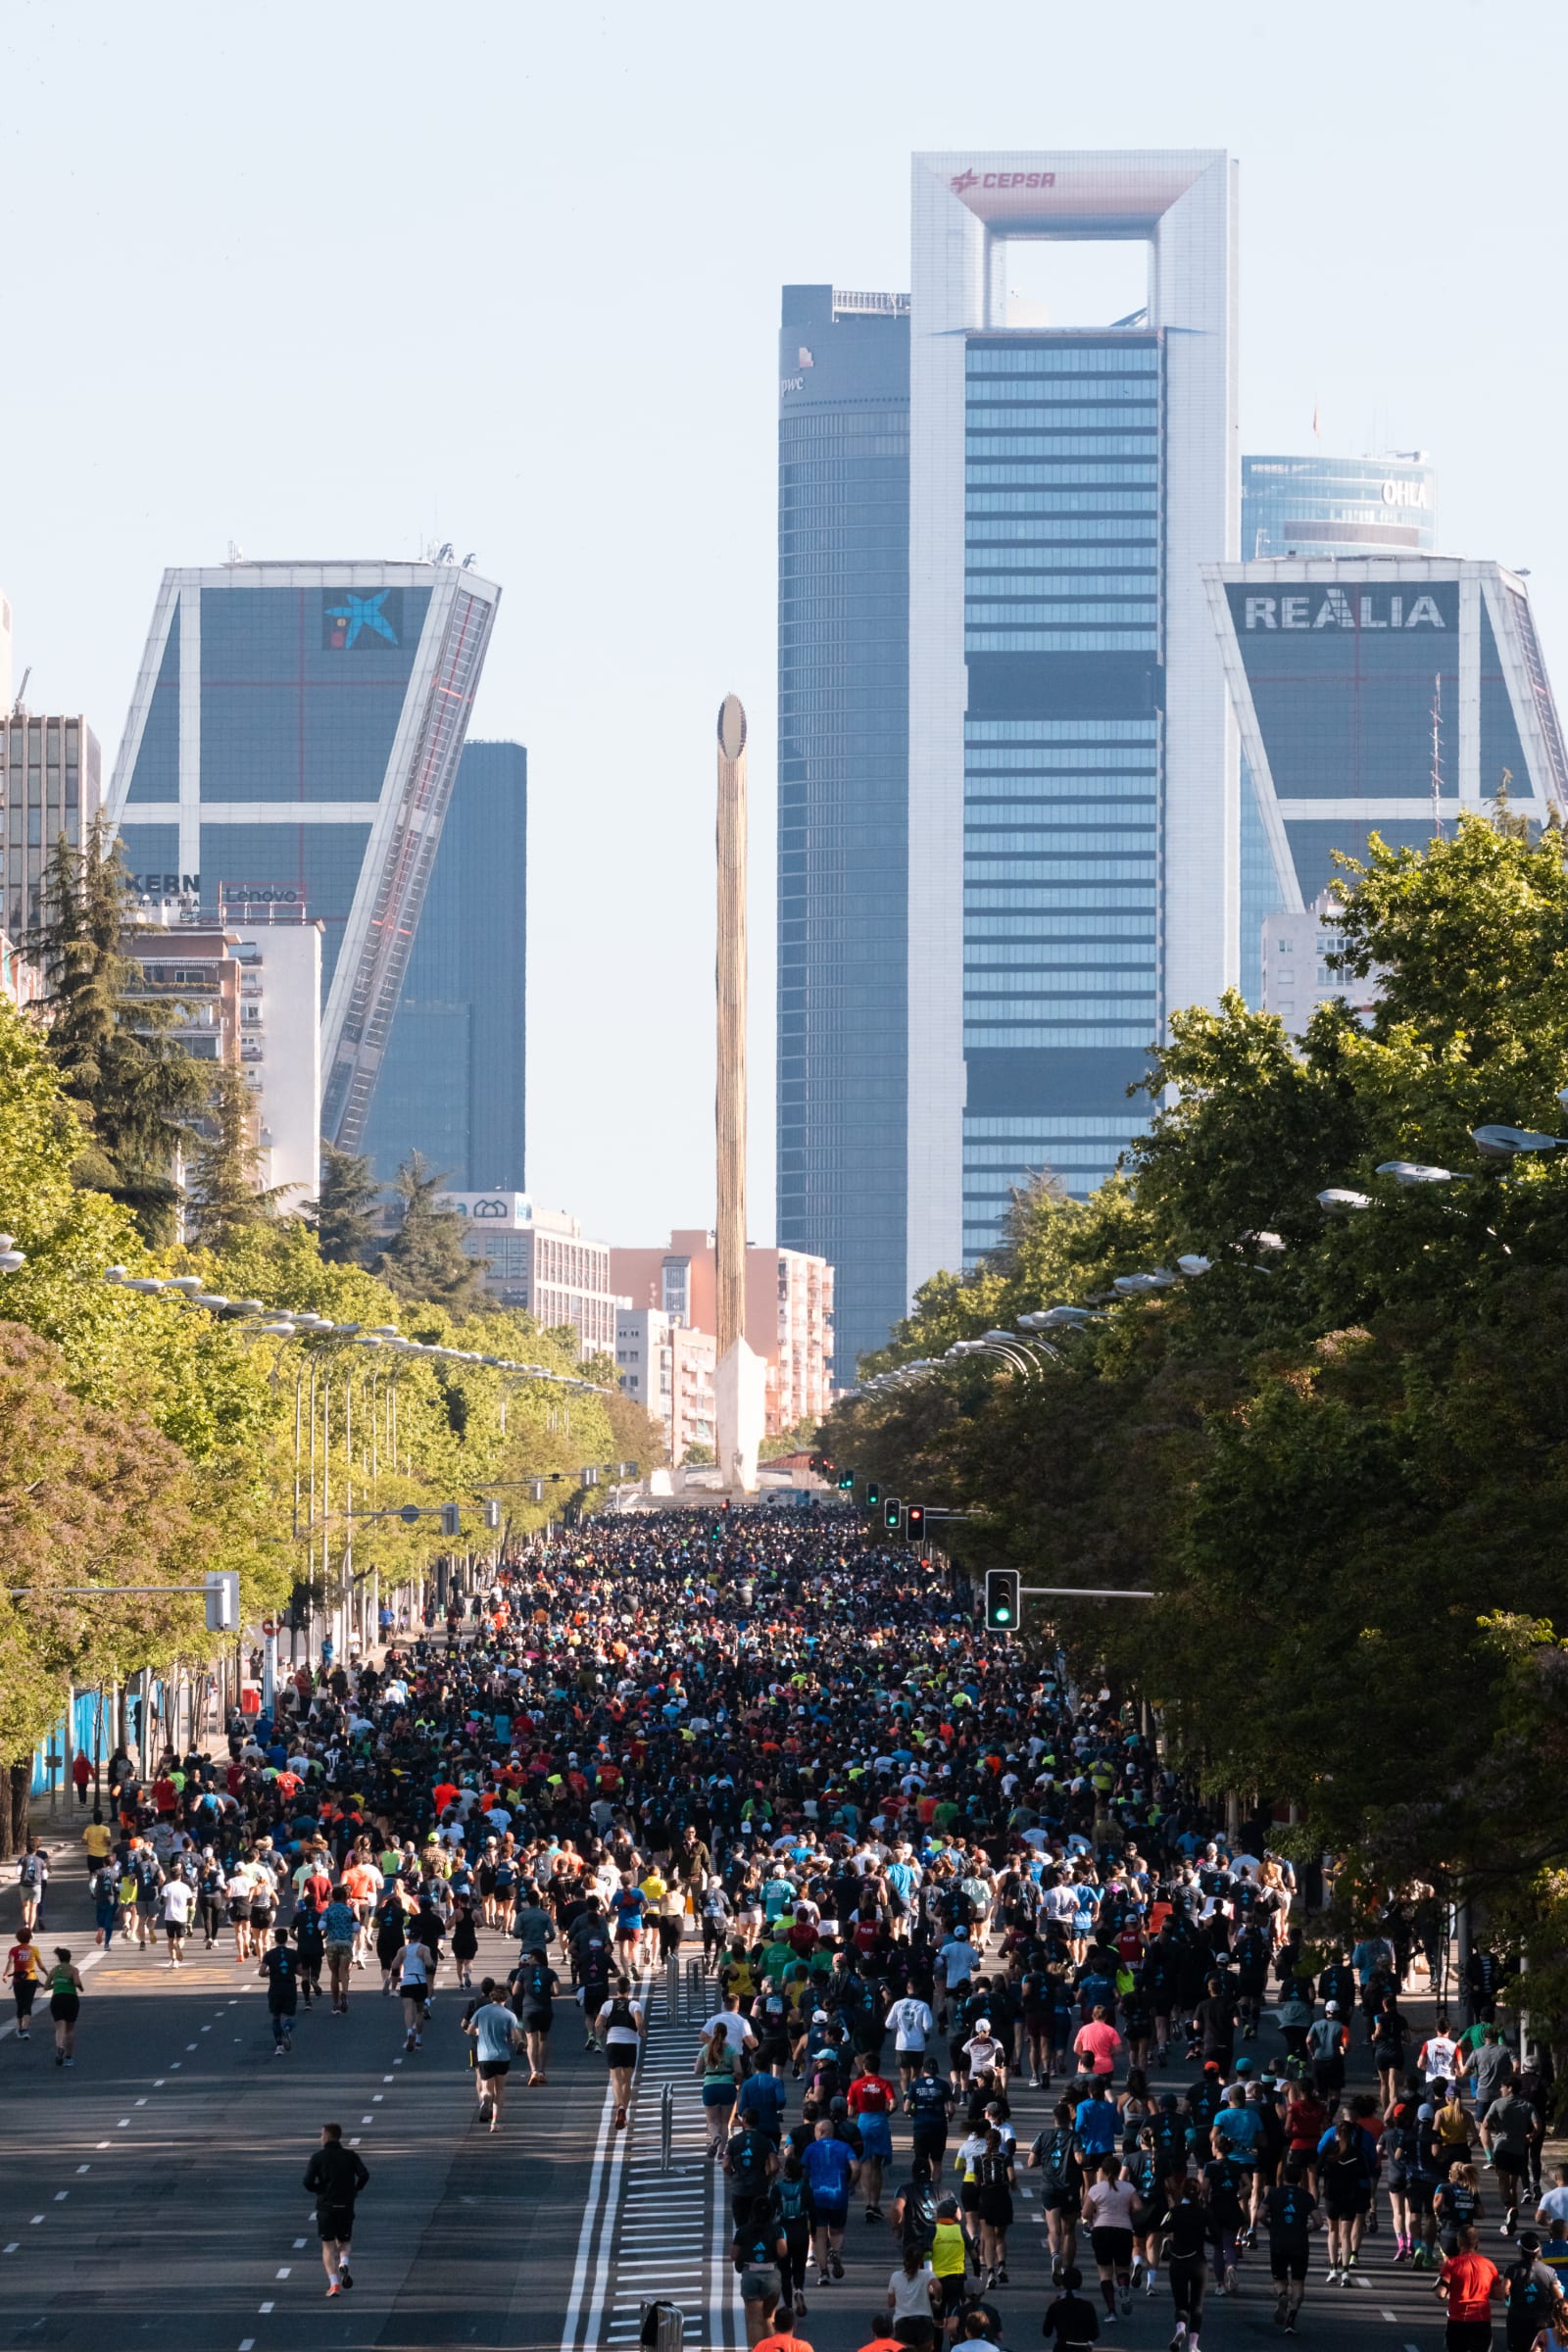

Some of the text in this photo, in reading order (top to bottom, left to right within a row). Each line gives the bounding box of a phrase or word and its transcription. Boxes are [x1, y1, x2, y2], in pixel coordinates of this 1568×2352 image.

[983, 172, 1055, 188] CEPSA
[780, 377, 804, 398] pwc
[1381, 479, 1428, 510] OHLA
[1246, 588, 1446, 629] REALIA
[124, 874, 200, 893] KERN
[226, 887, 297, 903] Lenovo
